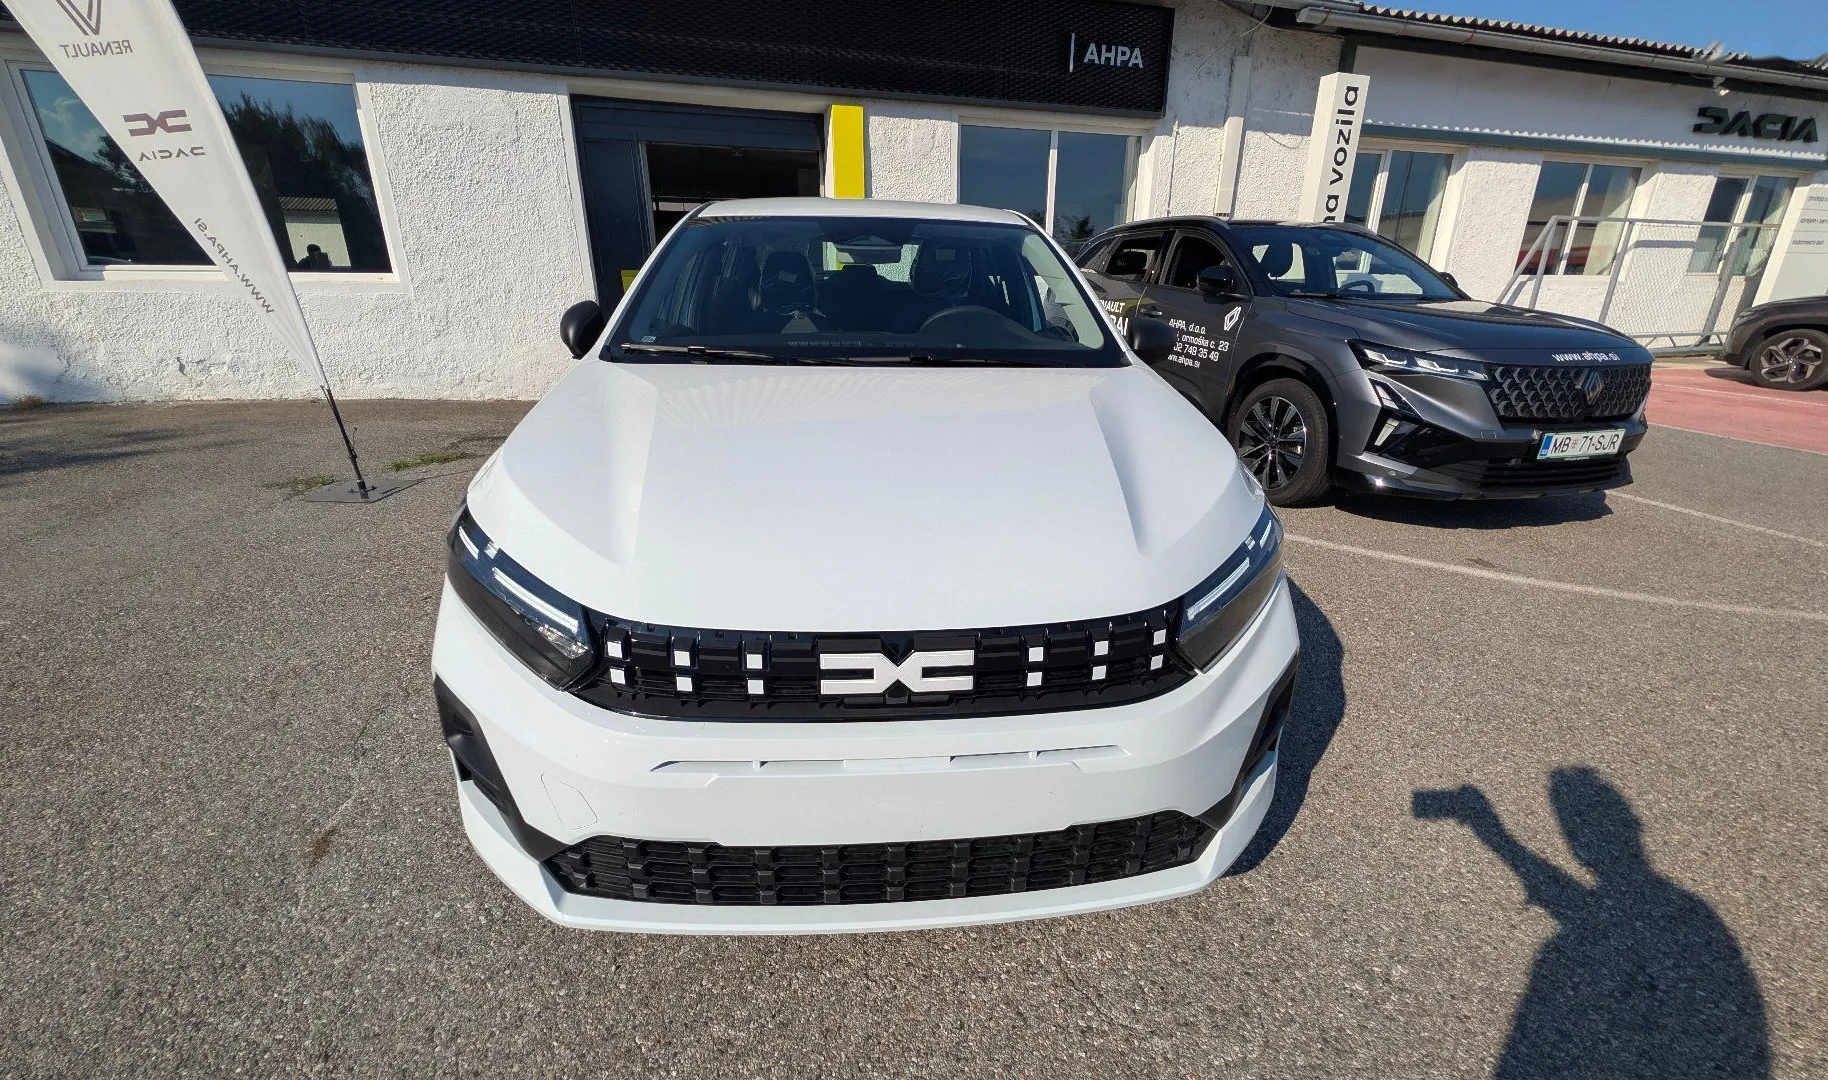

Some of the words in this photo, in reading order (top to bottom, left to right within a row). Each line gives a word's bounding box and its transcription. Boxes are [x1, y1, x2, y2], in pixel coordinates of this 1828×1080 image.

[1083, 42, 1144, 69] AHPA
[1692, 106, 1819, 143] DACIA
[1329, 85, 1360, 187] vozila
[1183, 343, 1198, 356] 749
[1197, 347, 1209, 359] 35
[1208, 350, 1220, 362] 49
[1217, 340, 1230, 352] 23
[1551, 350, 1621, 363] www.ahpa.si
[1550, 436, 1572, 454] MB
[1578, 433, 1620, 452] 71-SJR
